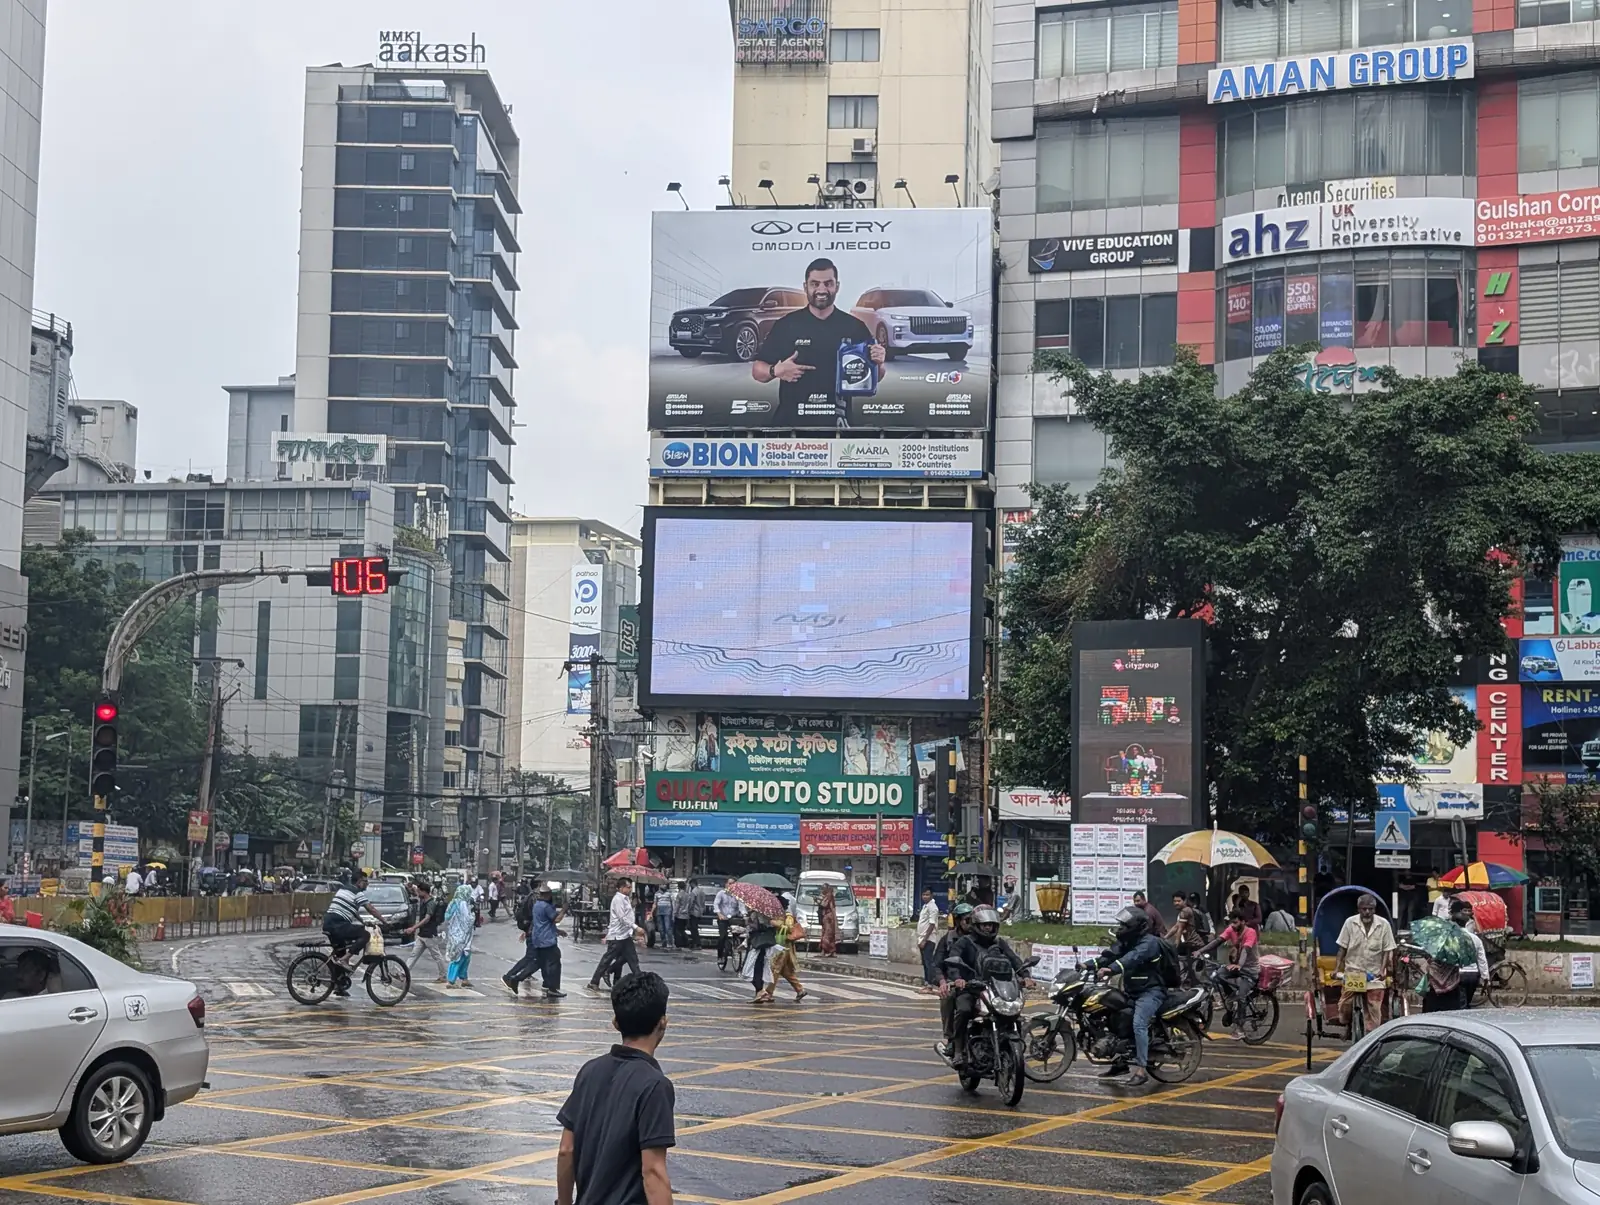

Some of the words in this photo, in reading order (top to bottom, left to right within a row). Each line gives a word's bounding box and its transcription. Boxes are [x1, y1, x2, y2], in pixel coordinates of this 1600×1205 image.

[738, 17, 825, 35] SARCO
[379, 30, 416, 42] MMK
[737, 38, 777, 47] ESTATE
[781, 38, 825, 47] AGENTS
[378, 32, 486, 63] aakash
[1213, 56, 1337, 102] AMAN
[1348, 44, 1469, 85] GROUP
[1326, 181, 1395, 202] Securities
[1332, 204, 1356, 218] UK
[1477, 198, 1552, 220] Gulshan
[797, 221, 893, 233] CHERY
[1331, 215, 1420, 232] University
[1062, 239, 1095, 251] VIVE
[1096, 233, 1173, 250] EDUCATION
[1228, 213, 1311, 259] ahz
[1332, 225, 1462, 247] Representative
[751, 241, 815, 251] OMODA
[824, 241, 891, 251] JAECOO
[1089, 250, 1135, 264] GROUP
[925, 371, 949, 384] elf
[730, 399, 748, 414] 5
[692, 441, 758, 467] BION
[765, 442, 793, 452] Study
[794, 442, 829, 451] Abroad
[901, 443, 926, 452] 2000+
[928, 443, 970, 452] Institutions
[765, 451, 795, 460] Global
[801, 451, 829, 460] Career
[901, 452, 926, 460] 5000+
[928, 452, 957, 460] Courses
[787, 460, 829, 468] Immigration
[901, 460, 915, 468] 32+
[916, 460, 952, 468] Countries
[333, 558, 387, 596] 106
[573, 604, 598, 616] pay
[1124, 661, 1160, 670] citygroup
[1489, 692, 1508, 781] CENTER
[723, 731, 759, 757] কুইক
[760, 731, 794, 754] ফটো
[656, 779, 728, 801] QUICK
[734, 780, 812, 804] PHOTO
[817, 781, 903, 806] STUDIO
[805, 833, 818, 842] CITY
[818, 833, 850, 842] MONETARY
